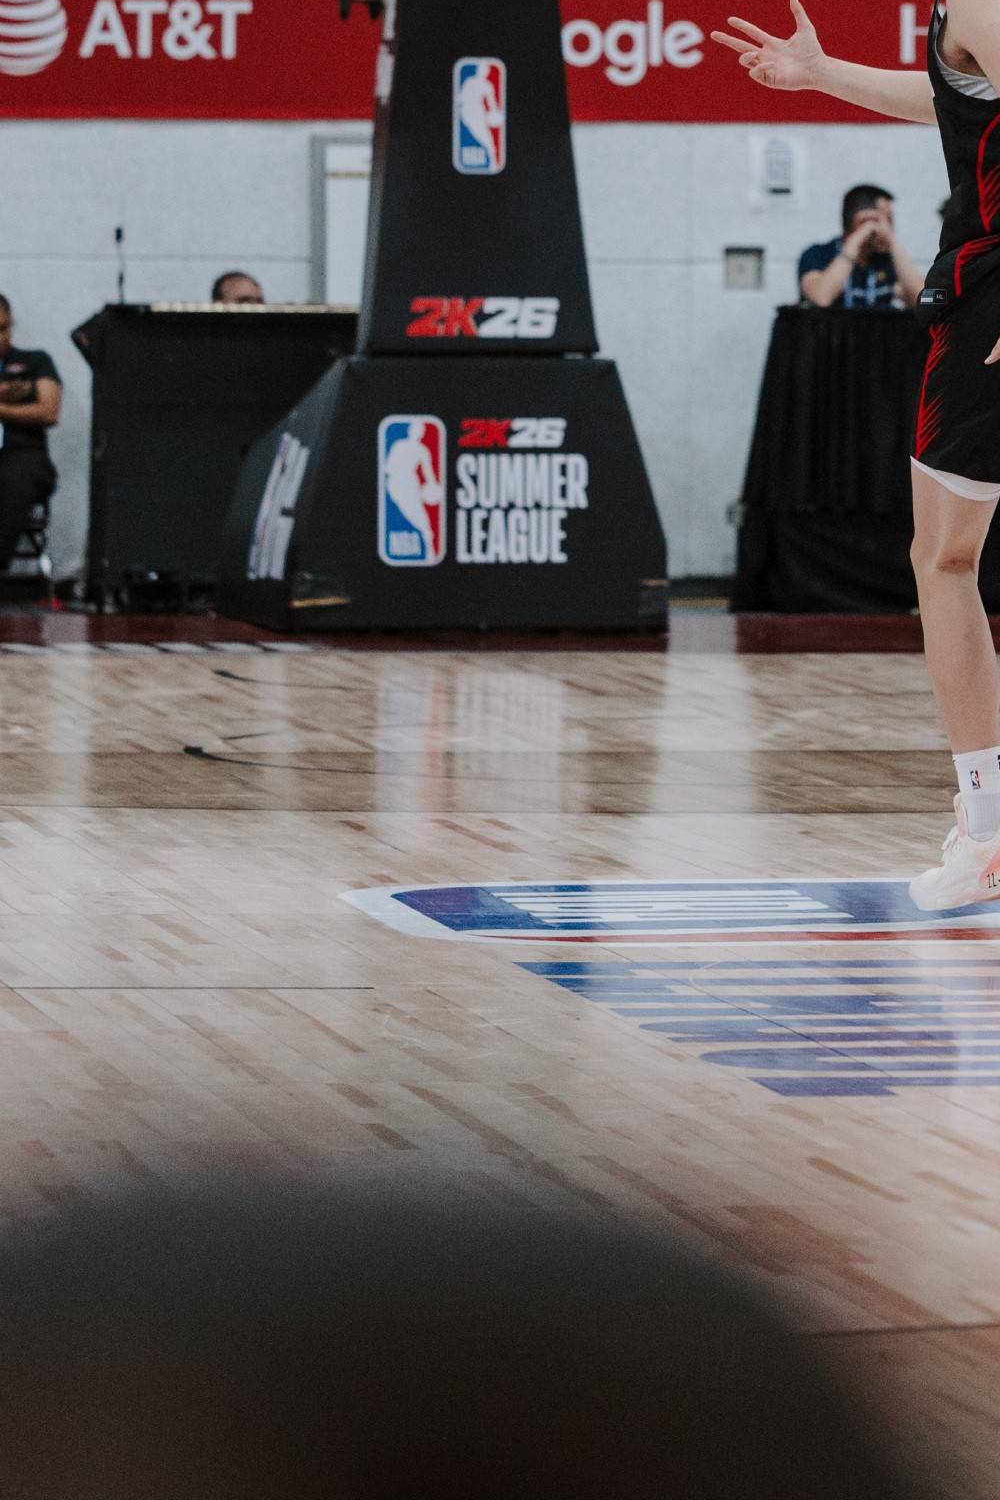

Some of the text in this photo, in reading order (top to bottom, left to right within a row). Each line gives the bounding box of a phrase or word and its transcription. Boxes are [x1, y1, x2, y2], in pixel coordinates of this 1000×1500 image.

[406, 296, 560, 338] 2K26
[458, 417, 567, 448] 2K26
[456, 453, 589, 509] SUMMER
[456, 508, 568, 564] LEAGUE
